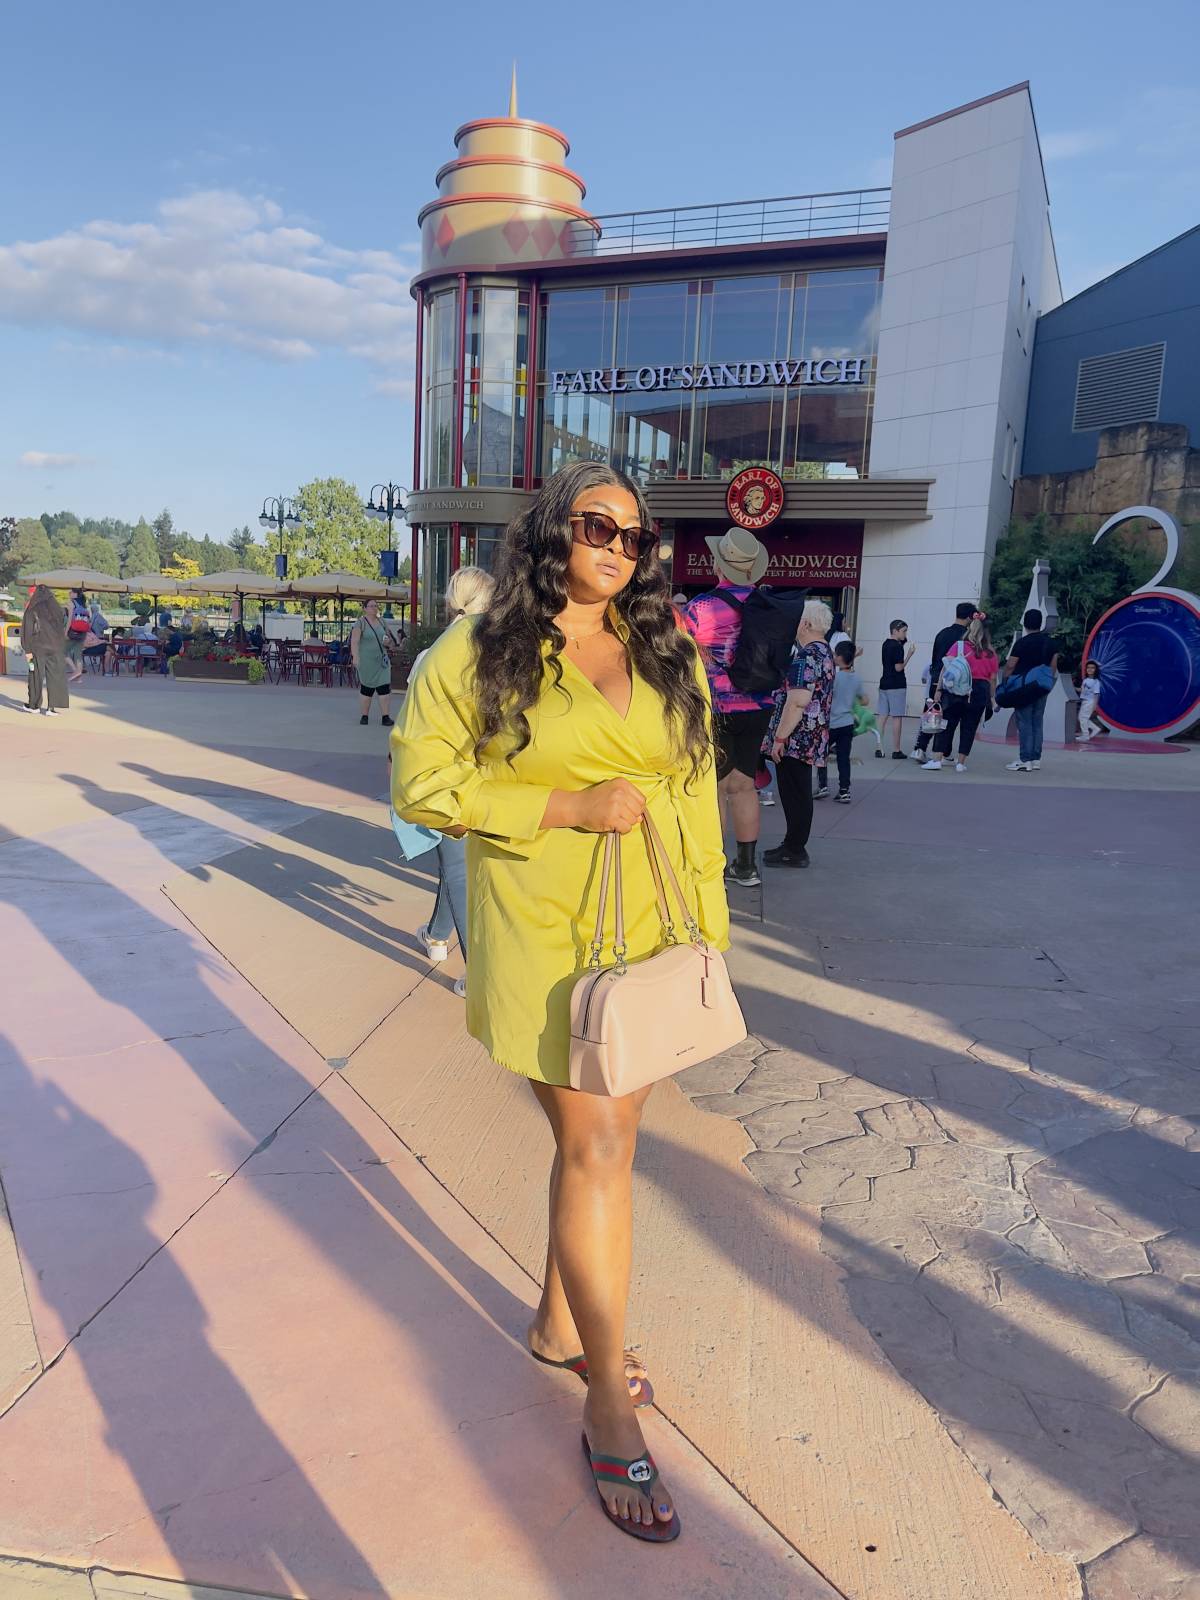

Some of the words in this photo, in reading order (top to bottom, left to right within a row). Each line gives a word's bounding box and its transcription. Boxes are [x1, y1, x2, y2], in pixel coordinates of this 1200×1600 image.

[551, 368, 628, 394] EARL
[635, 366, 675, 391] OF
[680, 359, 865, 389] SANDWICH
[734, 471, 762, 490] EARL
[765, 476, 779, 489] OF
[731, 502, 779, 526] SANDWICH
[768, 554, 858, 569] ANDWICH
[686, 568, 703, 576] THE
[788, 570, 807, 578] HOT
[809, 571, 858, 579] SANDWICH
